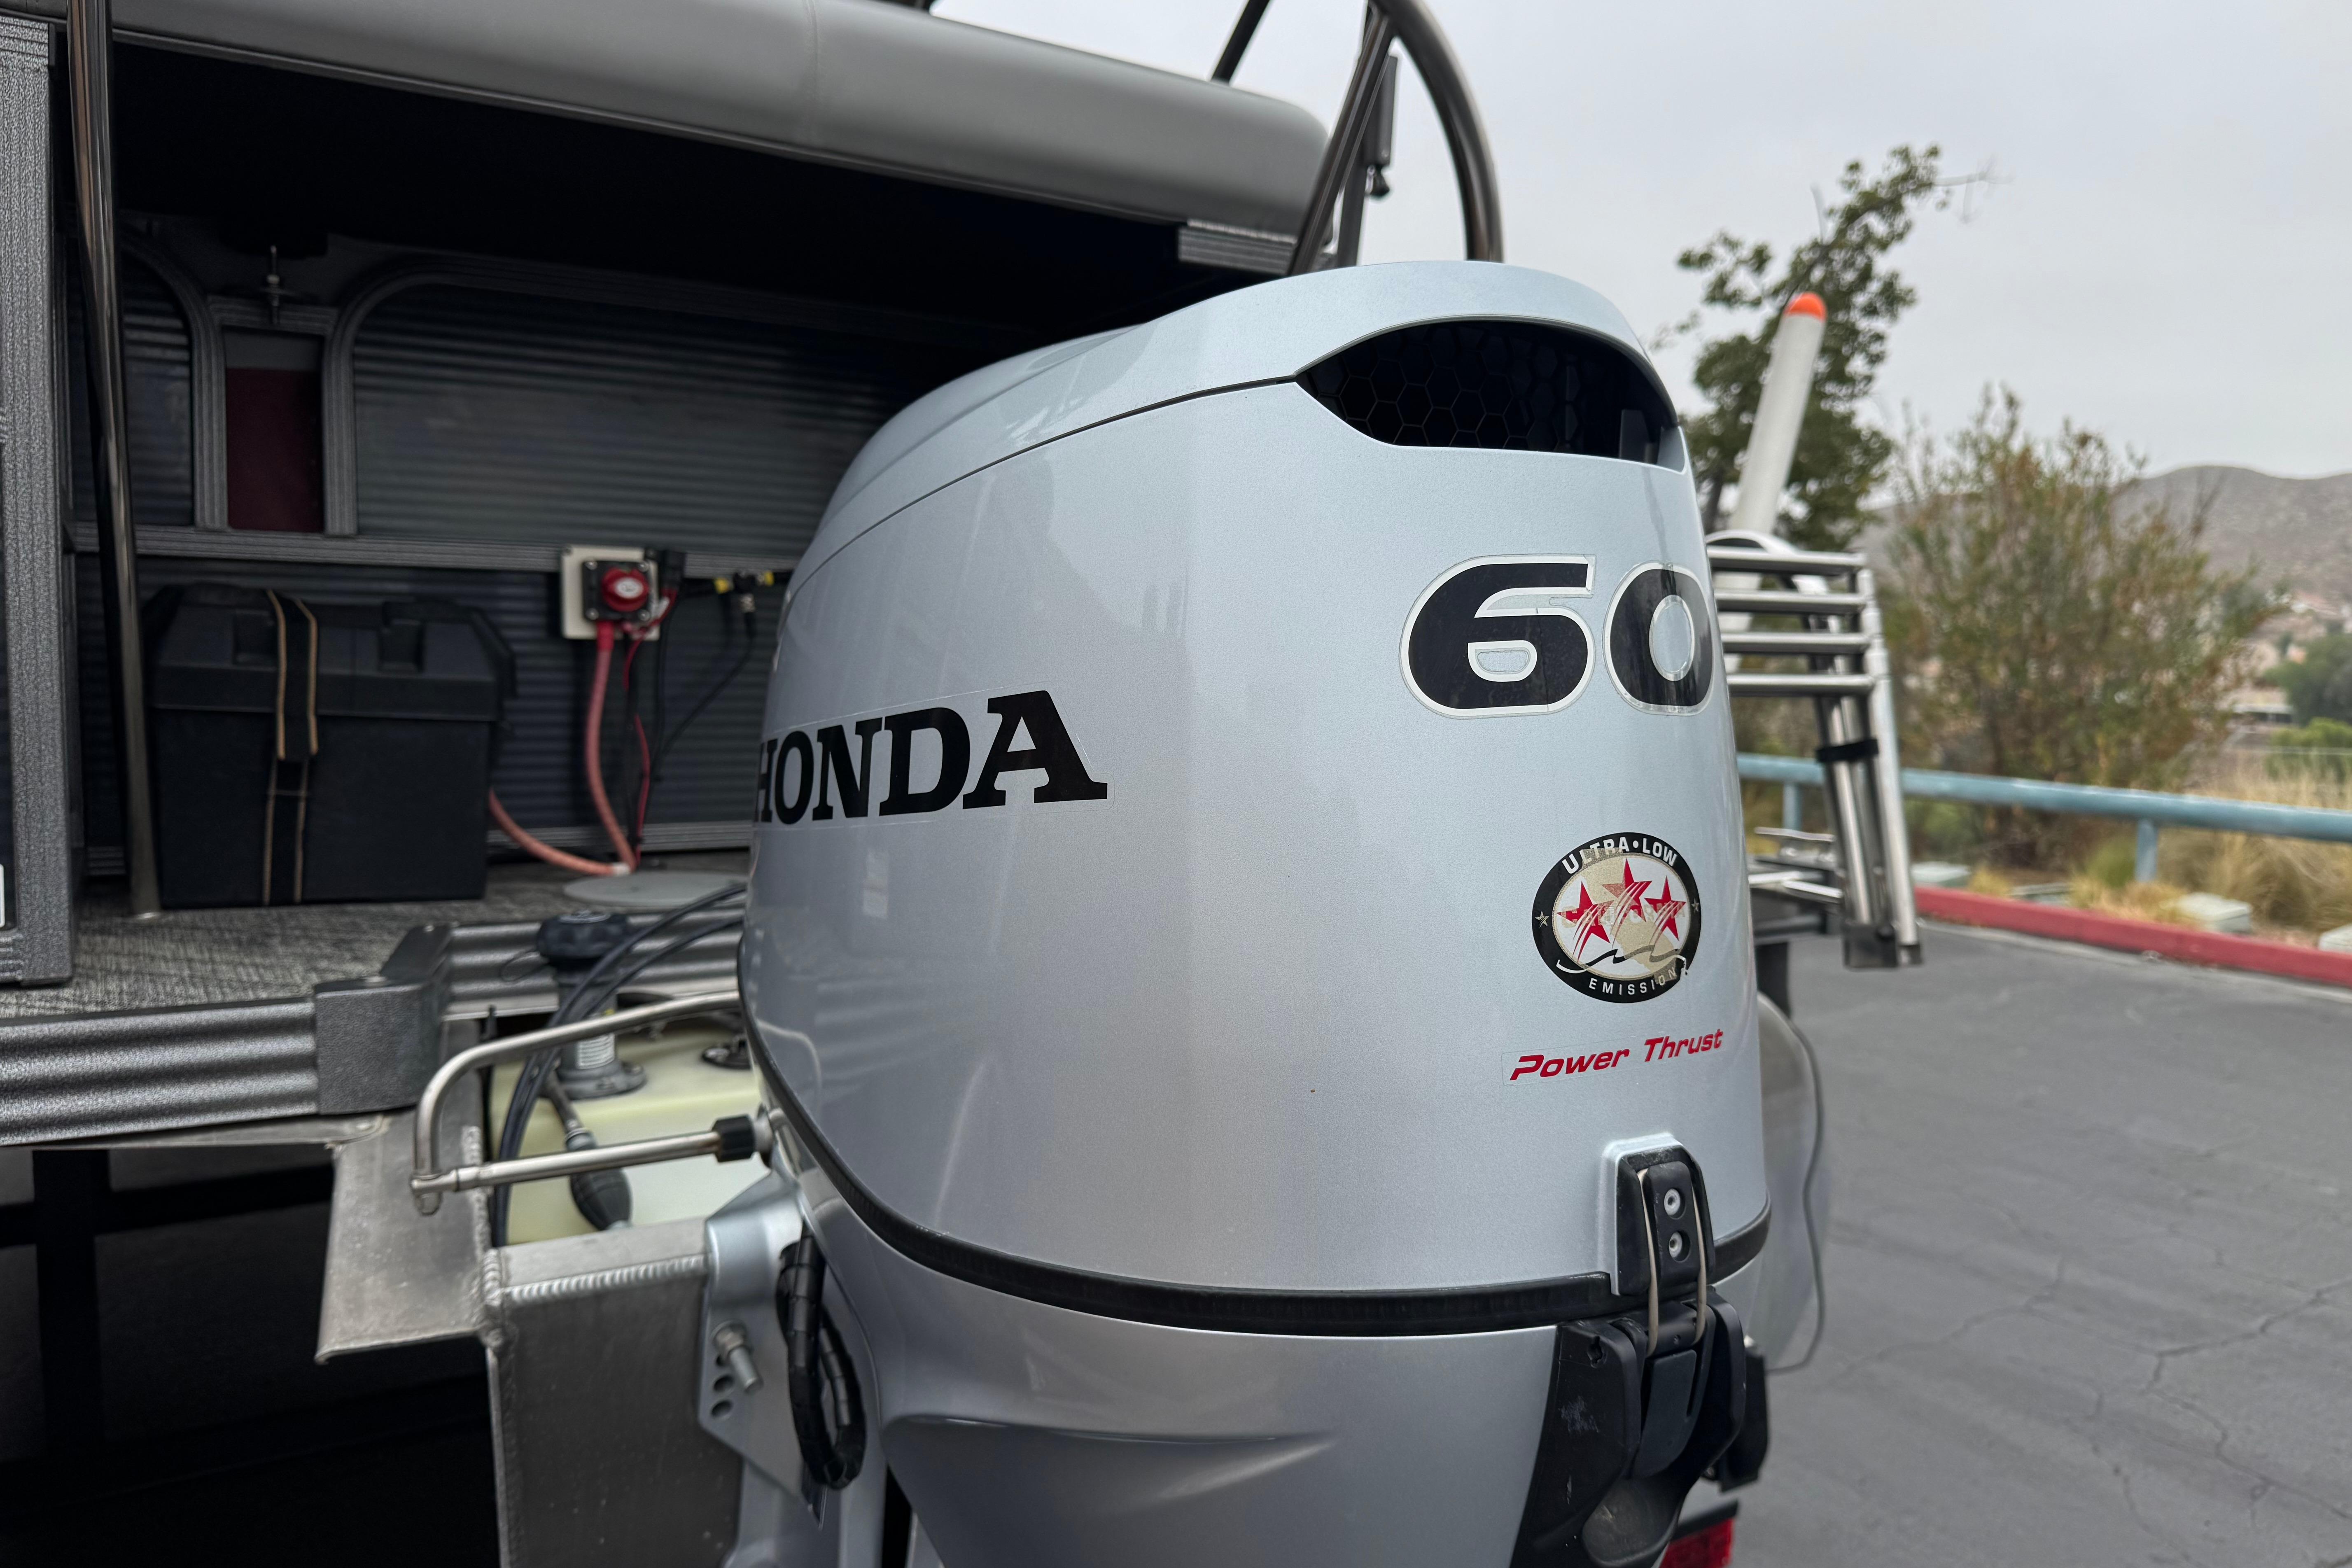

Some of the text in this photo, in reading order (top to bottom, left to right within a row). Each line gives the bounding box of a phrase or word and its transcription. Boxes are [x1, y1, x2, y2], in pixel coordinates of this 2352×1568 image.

[1401, 555, 1716, 717] 60
[754, 690, 1108, 825] HONDA
[1589, 966, 1677, 995] EMISSION
[1509, 1028, 1724, 1081] Power Thrust
